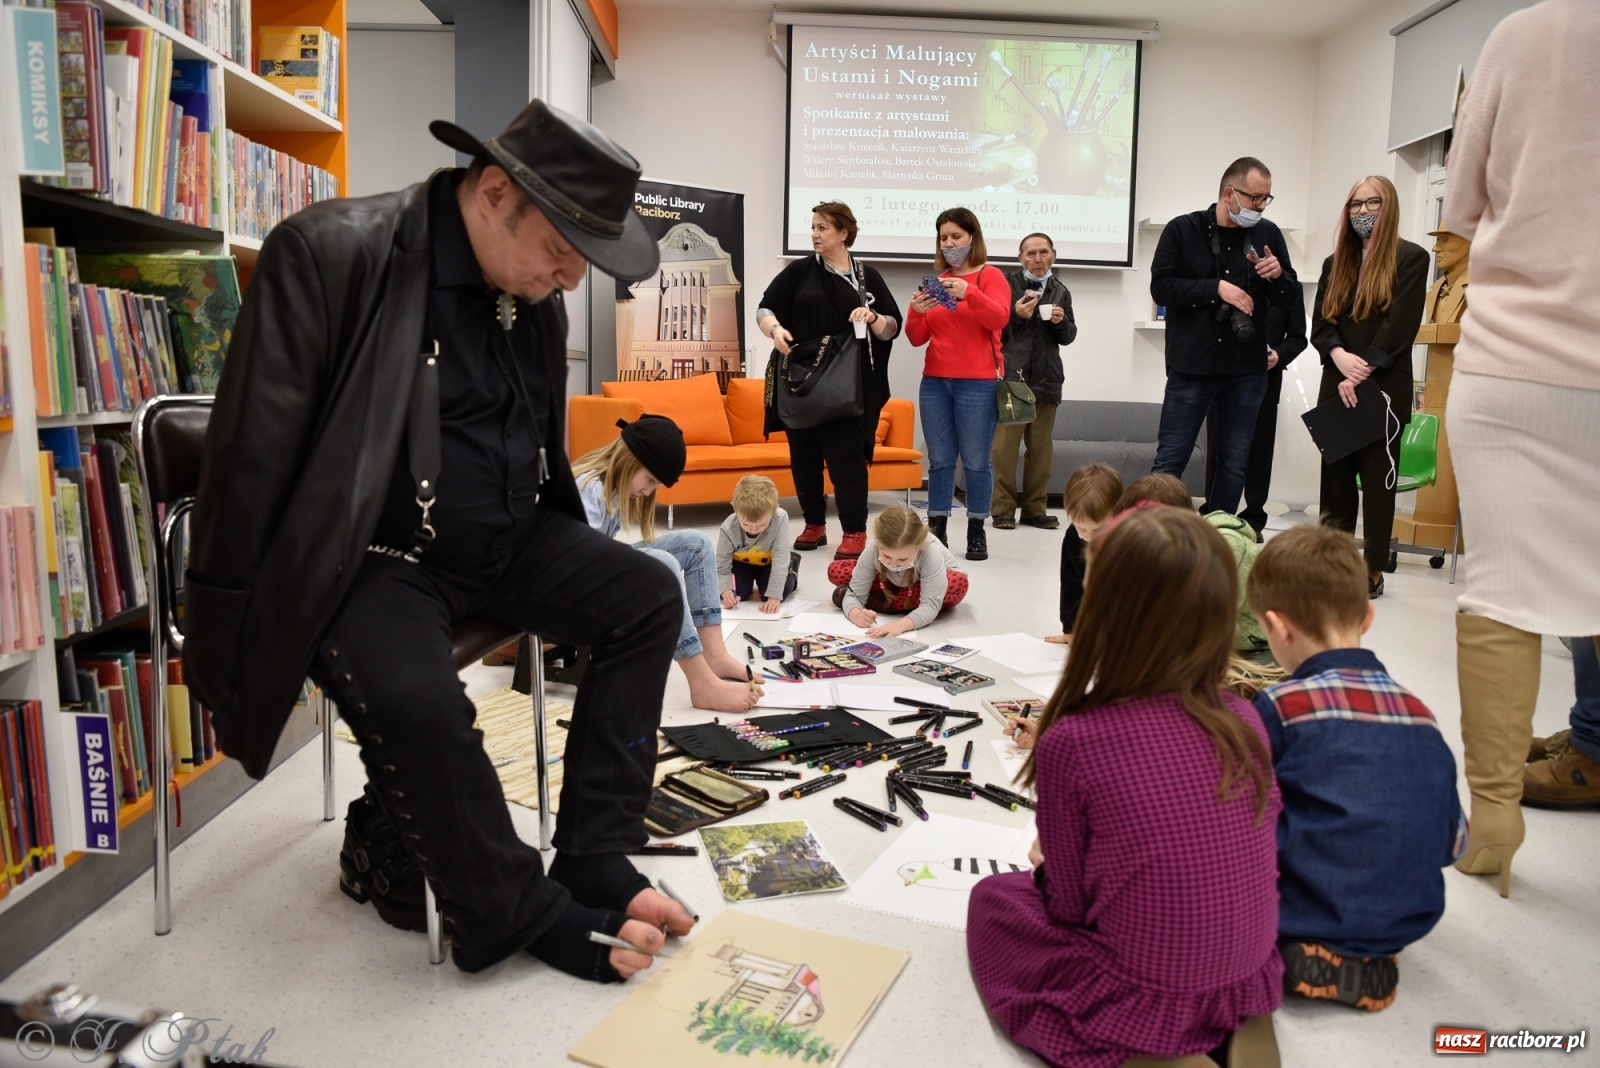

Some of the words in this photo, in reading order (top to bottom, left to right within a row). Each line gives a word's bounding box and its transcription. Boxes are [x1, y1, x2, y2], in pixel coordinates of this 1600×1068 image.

[804, 42, 877, 63] Artyści
[885, 44, 978, 67] Malujący
[802, 67, 877, 84] Ustami
[883, 69, 890, 84] i
[898, 69, 979, 91] Nogami
[27, 40, 50, 145] KOMIKSY
[835, 91, 890, 100] wernisaż
[895, 93, 947, 104] wystawy
[803, 106, 871, 122] Spotkanie
[875, 111, 883, 120] z
[886, 110, 950, 124] artystami
[802, 125, 808, 136] i
[812, 126, 889, 141] prezentacja
[893, 127, 970, 140] malowania:
[891, 143, 937, 155] Katarzyna
[803, 155, 834, 166] Walery
[895, 156, 924, 166] Bartek
[840, 169, 880, 180] Kastelik,
[882, 170, 924, 182] Martynka
[926, 171, 955, 181] Gruca
[634, 192, 668, 206] Public
[669, 196, 706, 213] Library
[864, 196, 873, 210] 2
[1014, 200, 1060, 215] 17.00
[634, 205, 681, 220] Raciborz
[1011, 222, 1025, 231] ul.
[1030, 222, 1101, 234] Kasprowicza
[1106, 225, 1117, 234] 12
[84, 733, 110, 824] BAŚNIE
[97, 834, 110, 848] B
